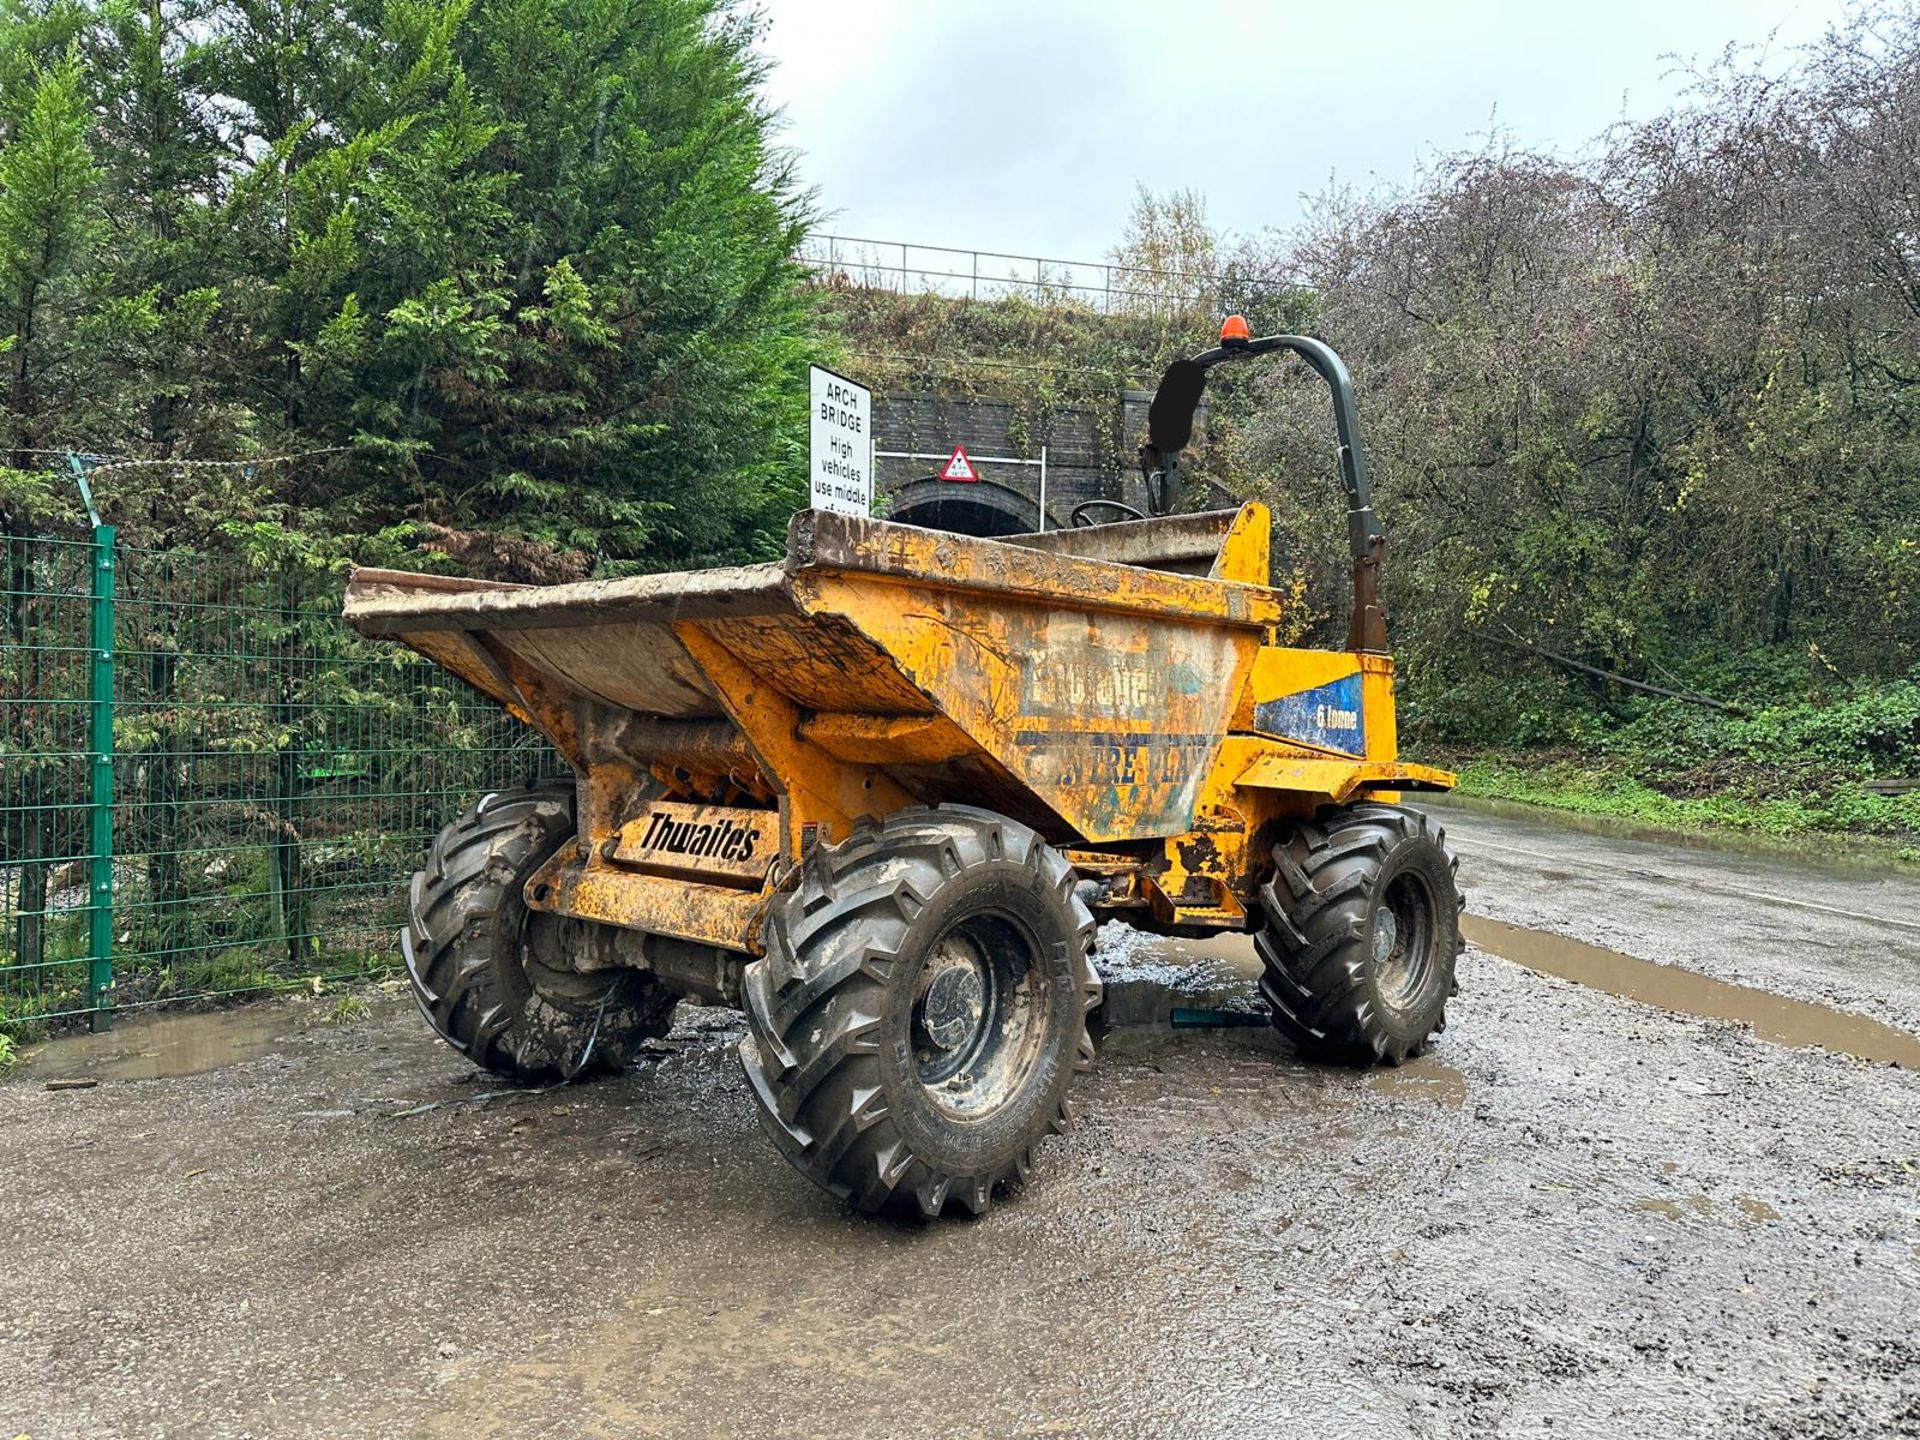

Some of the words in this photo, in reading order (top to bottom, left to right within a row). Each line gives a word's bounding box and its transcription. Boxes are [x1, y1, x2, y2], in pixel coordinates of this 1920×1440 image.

[827, 382, 858, 409] ARCH
[821, 402, 862, 433] BRIDGE
[830, 435, 853, 459] High
[821, 458, 861, 482] vehicles
[815, 480, 832, 497] use
[834, 484, 867, 506] middle
[1327, 705, 1358, 731] tonne
[640, 812, 760, 862] Thwaites
